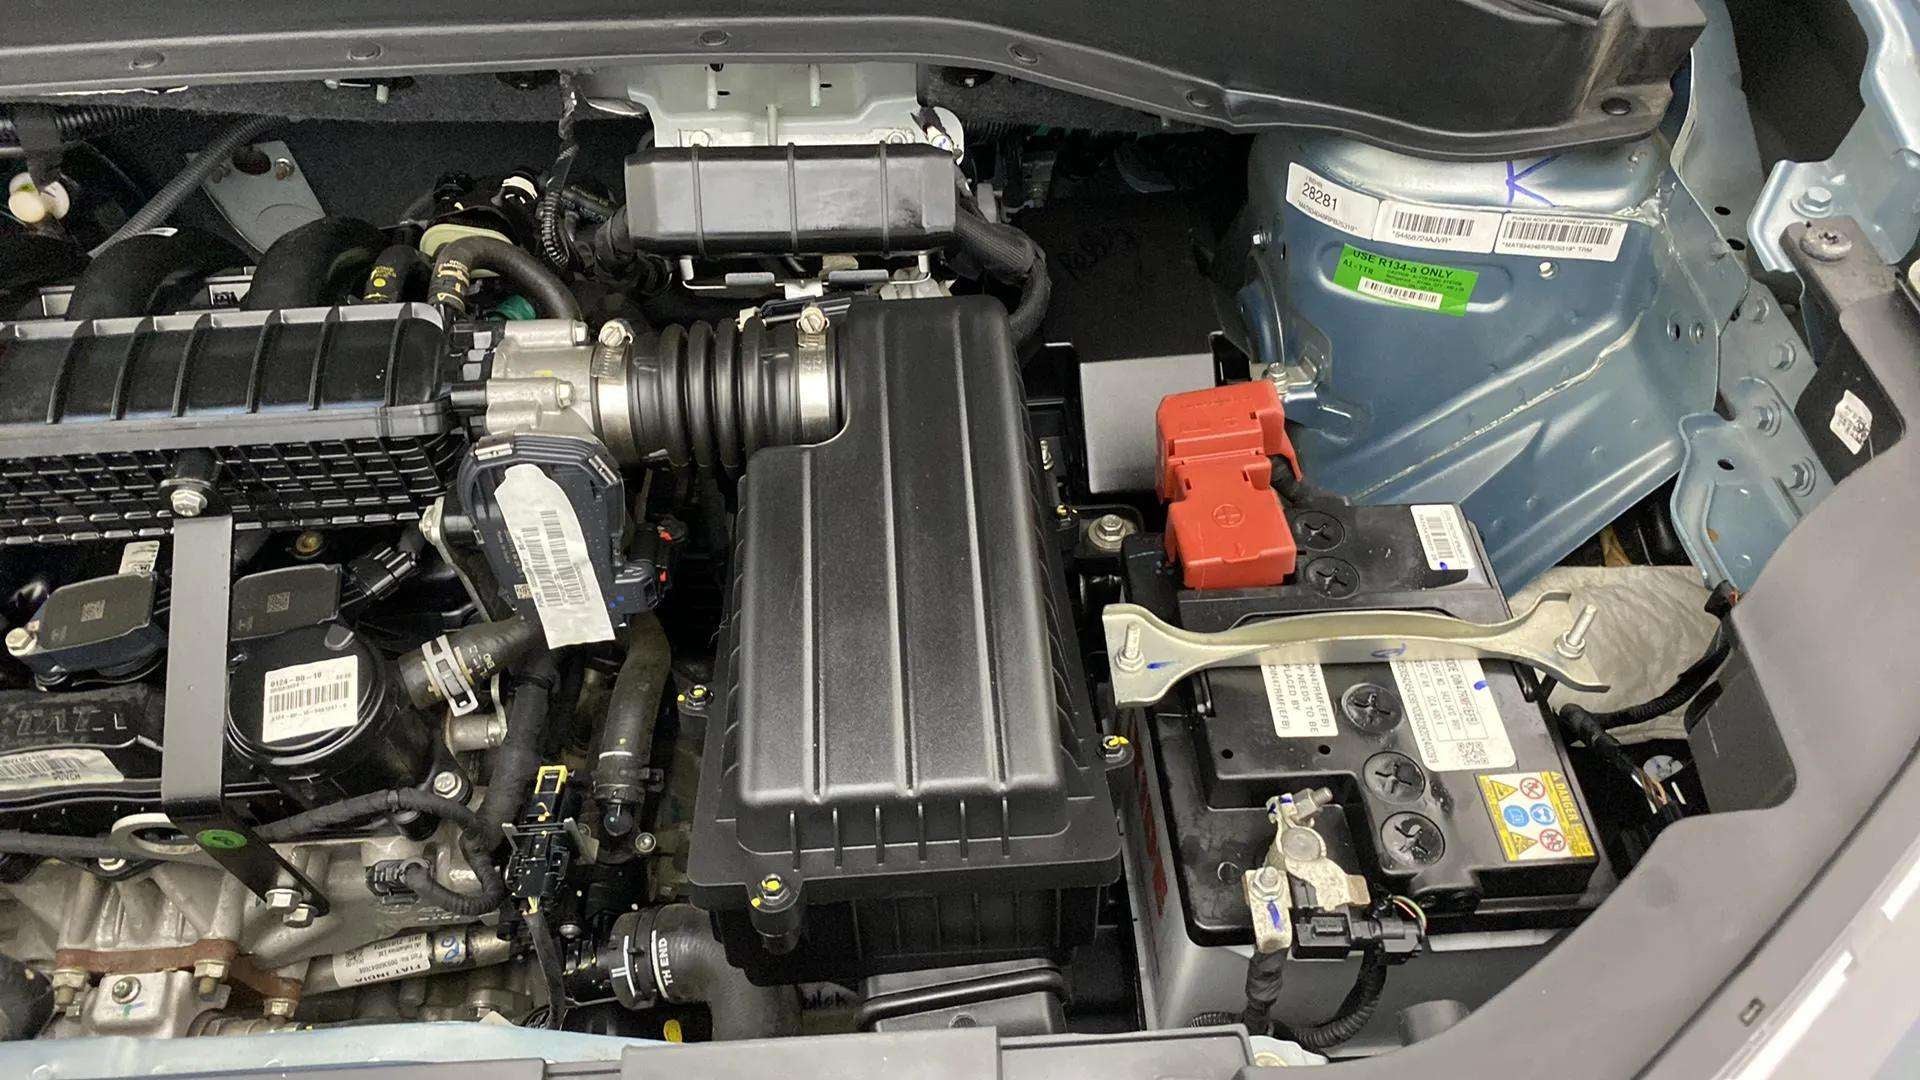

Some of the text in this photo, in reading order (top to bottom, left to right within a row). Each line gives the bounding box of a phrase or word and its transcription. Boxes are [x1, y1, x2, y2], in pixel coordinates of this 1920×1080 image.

[1302, 182, 1337, 211] 28281
[1353, 249, 1454, 279] USE R134-a ONLY
[1297, 673, 1311, 703] NEEDS
[1291, 699, 1300, 711] BY
[1306, 705, 1315, 718] TO
[1308, 721, 1319, 734] BE
[1556, 783, 1580, 821] DANGER
[658, 937, 674, 986] TH END
